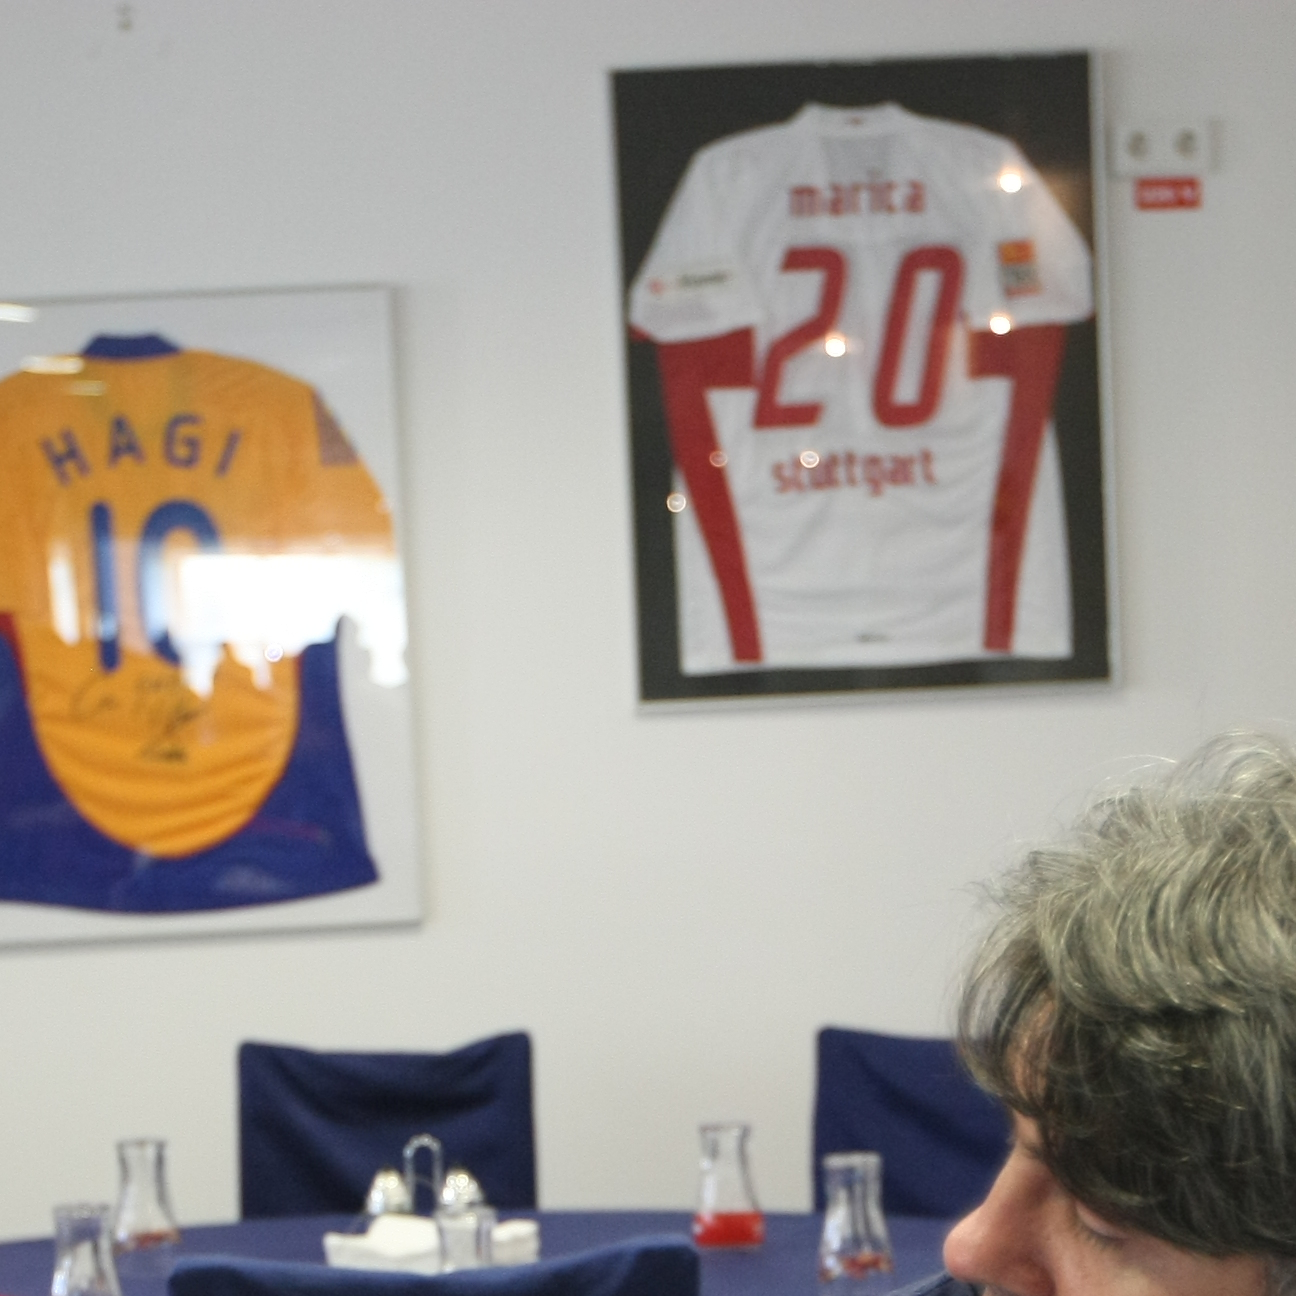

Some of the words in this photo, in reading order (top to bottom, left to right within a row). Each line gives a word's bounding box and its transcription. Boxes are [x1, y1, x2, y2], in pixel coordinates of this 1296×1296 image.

[789, 179, 927, 217] marica
[752, 245, 967, 430] 20
[39, 413, 245, 488] HAGI
[771, 447, 939, 497] stuttgart
